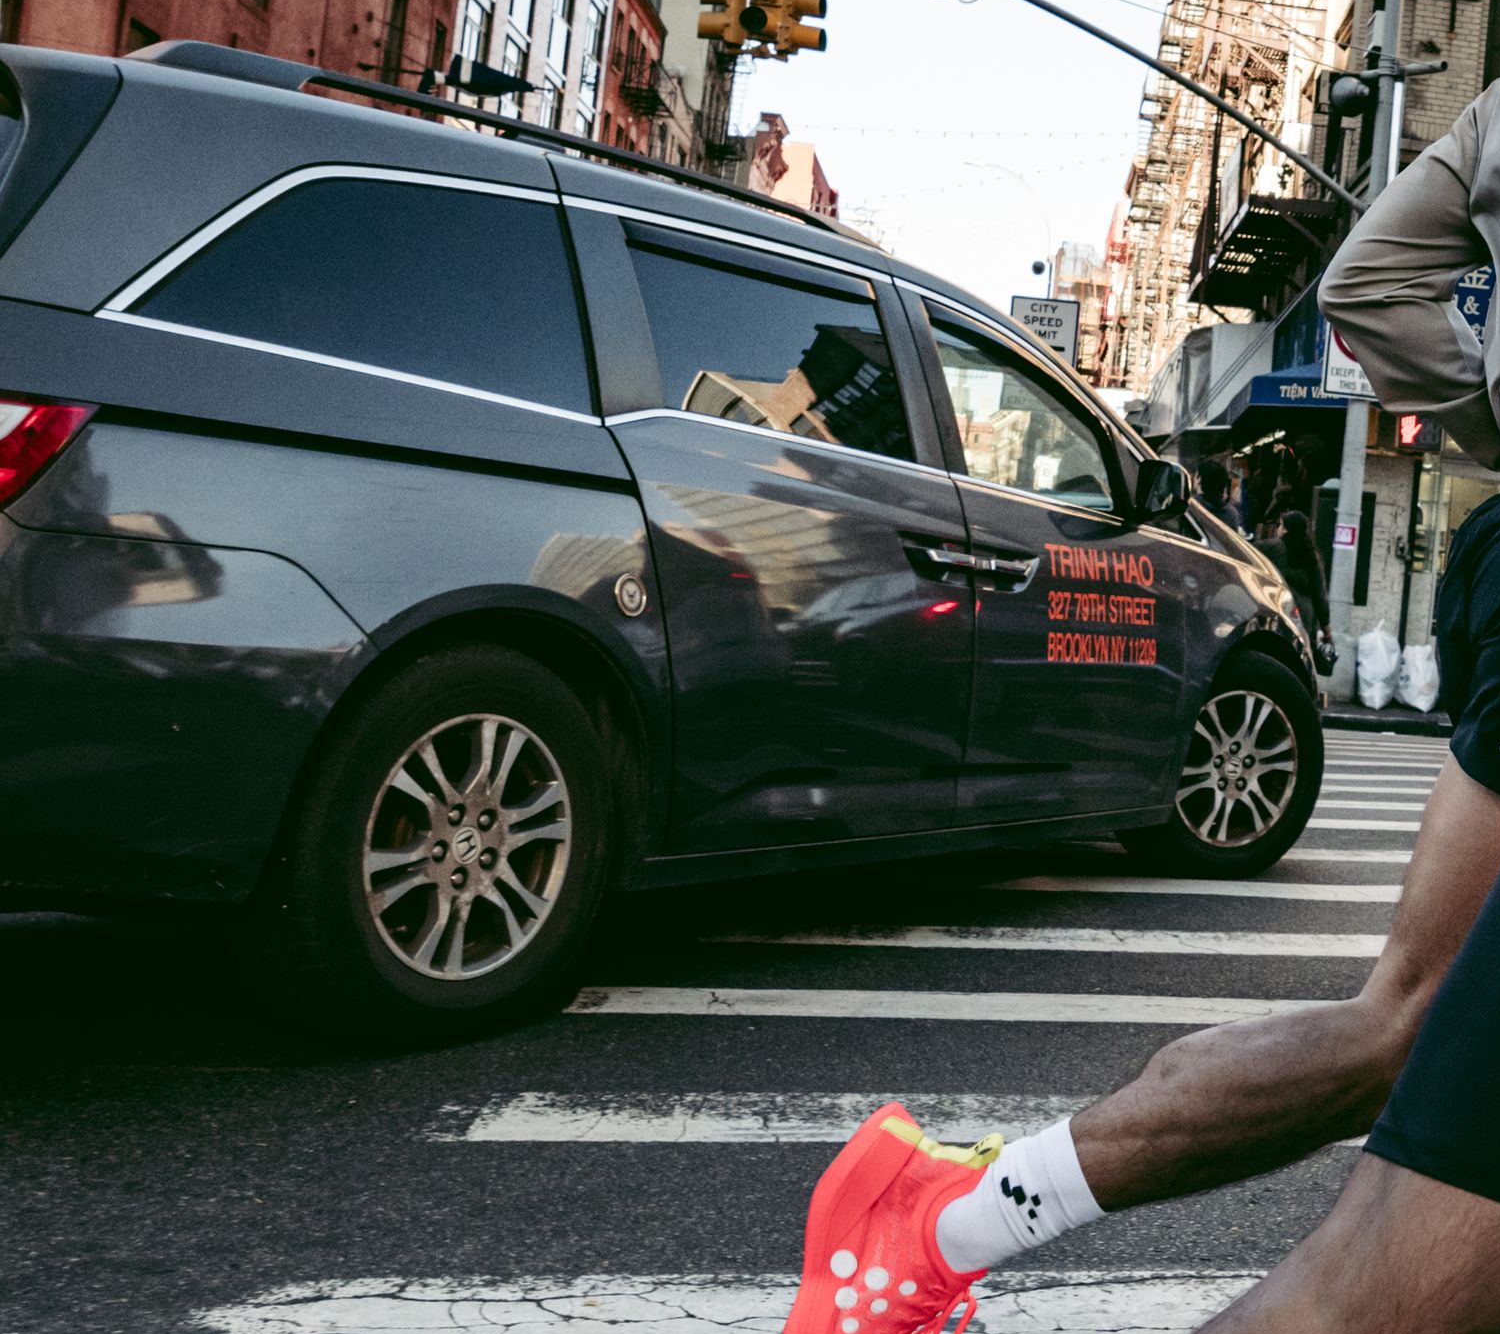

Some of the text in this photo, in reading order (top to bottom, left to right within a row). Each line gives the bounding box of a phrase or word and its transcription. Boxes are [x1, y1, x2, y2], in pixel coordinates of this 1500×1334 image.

[1030, 303, 1058, 314] CITY
[1023, 315, 1063, 328] SPEED
[1330, 366, 1355, 377] EXCEPT
[1279, 383, 1307, 400] TIỆM
[1339, 380, 1356, 391] THIS
[1044, 542, 1154, 587] TRINH HAO
[1048, 590, 1156, 625] 327 79TH STREET
[1047, 632, 1157, 666] BROOKLYN NY 11209
